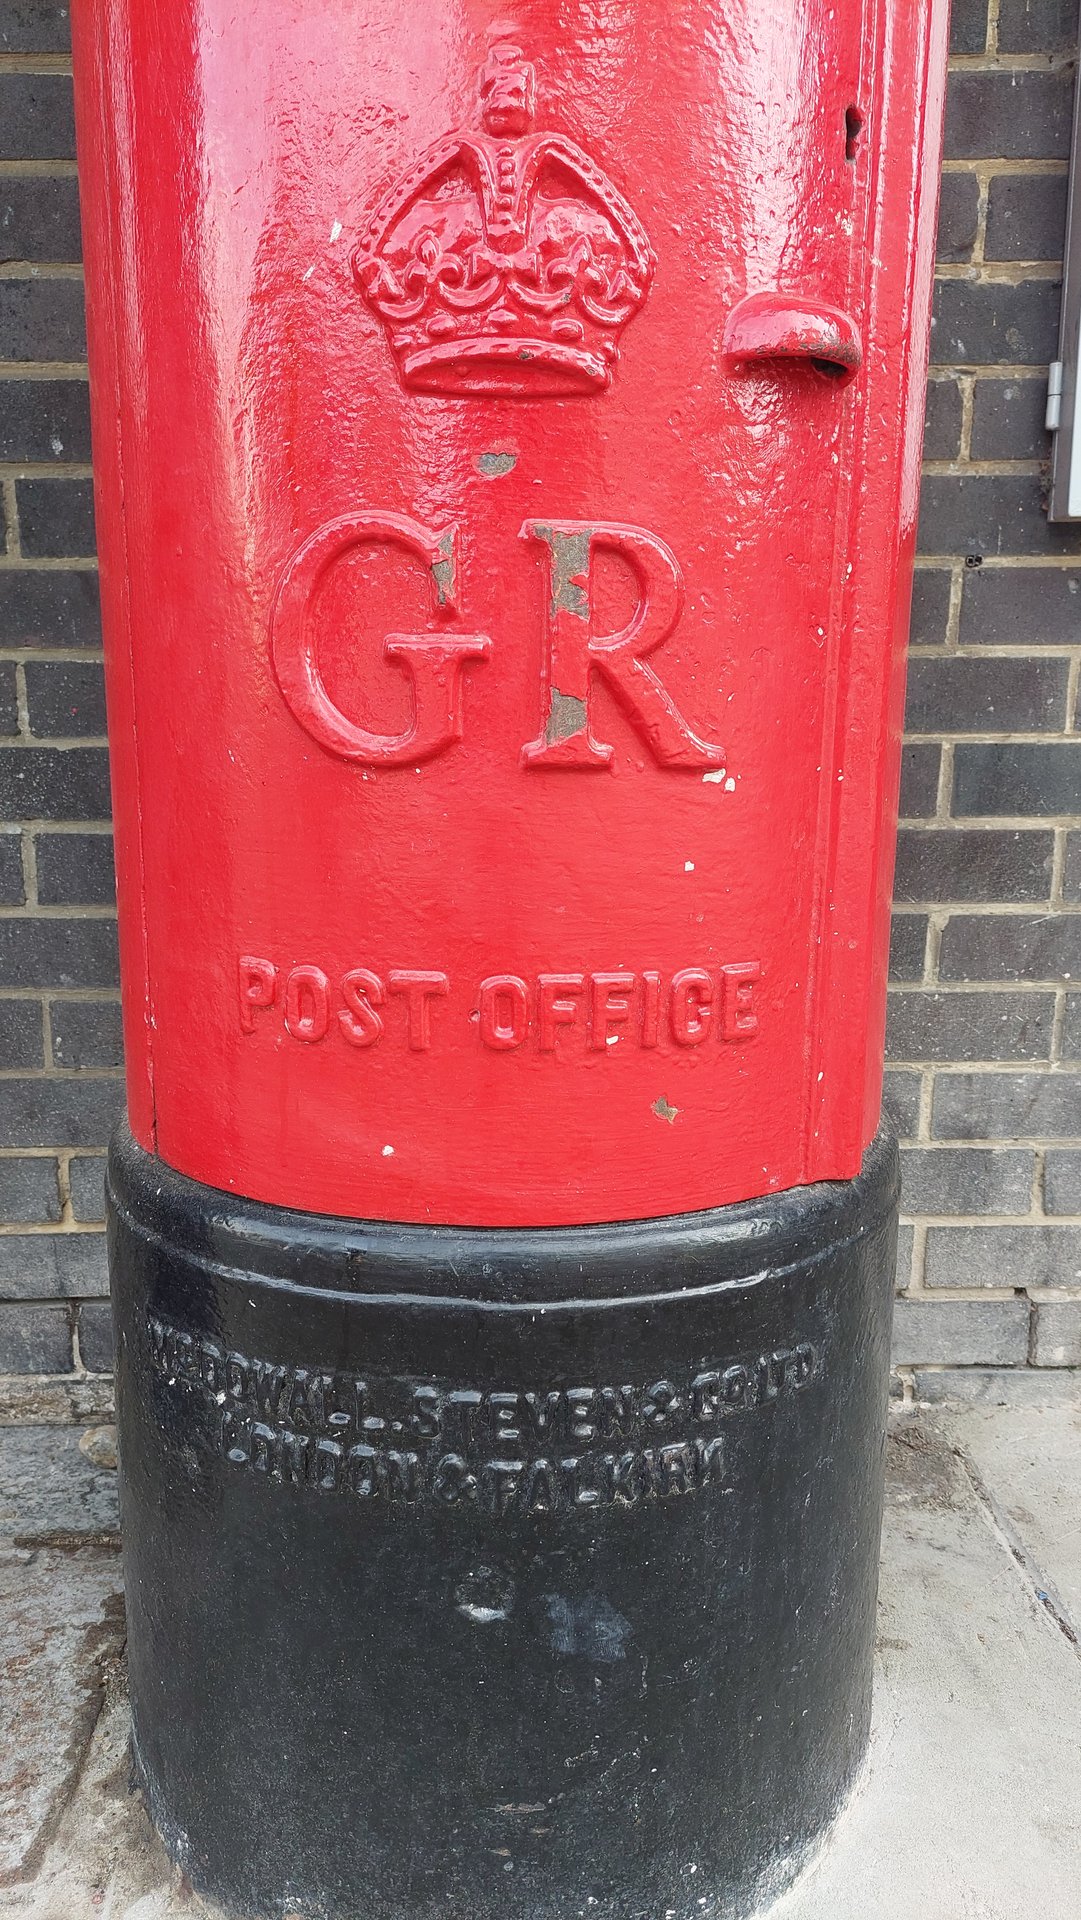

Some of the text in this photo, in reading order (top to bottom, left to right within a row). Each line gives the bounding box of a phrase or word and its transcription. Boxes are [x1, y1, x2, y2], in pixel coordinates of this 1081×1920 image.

[268, 508, 727, 768] GR
[238, 955, 762, 1051] POST OFFICE
[220, 1408, 728, 1510] LONDON & FALKIRK
[409, 1384, 634, 1441] STEVEN
[641, 1379, 683, 1428] &
